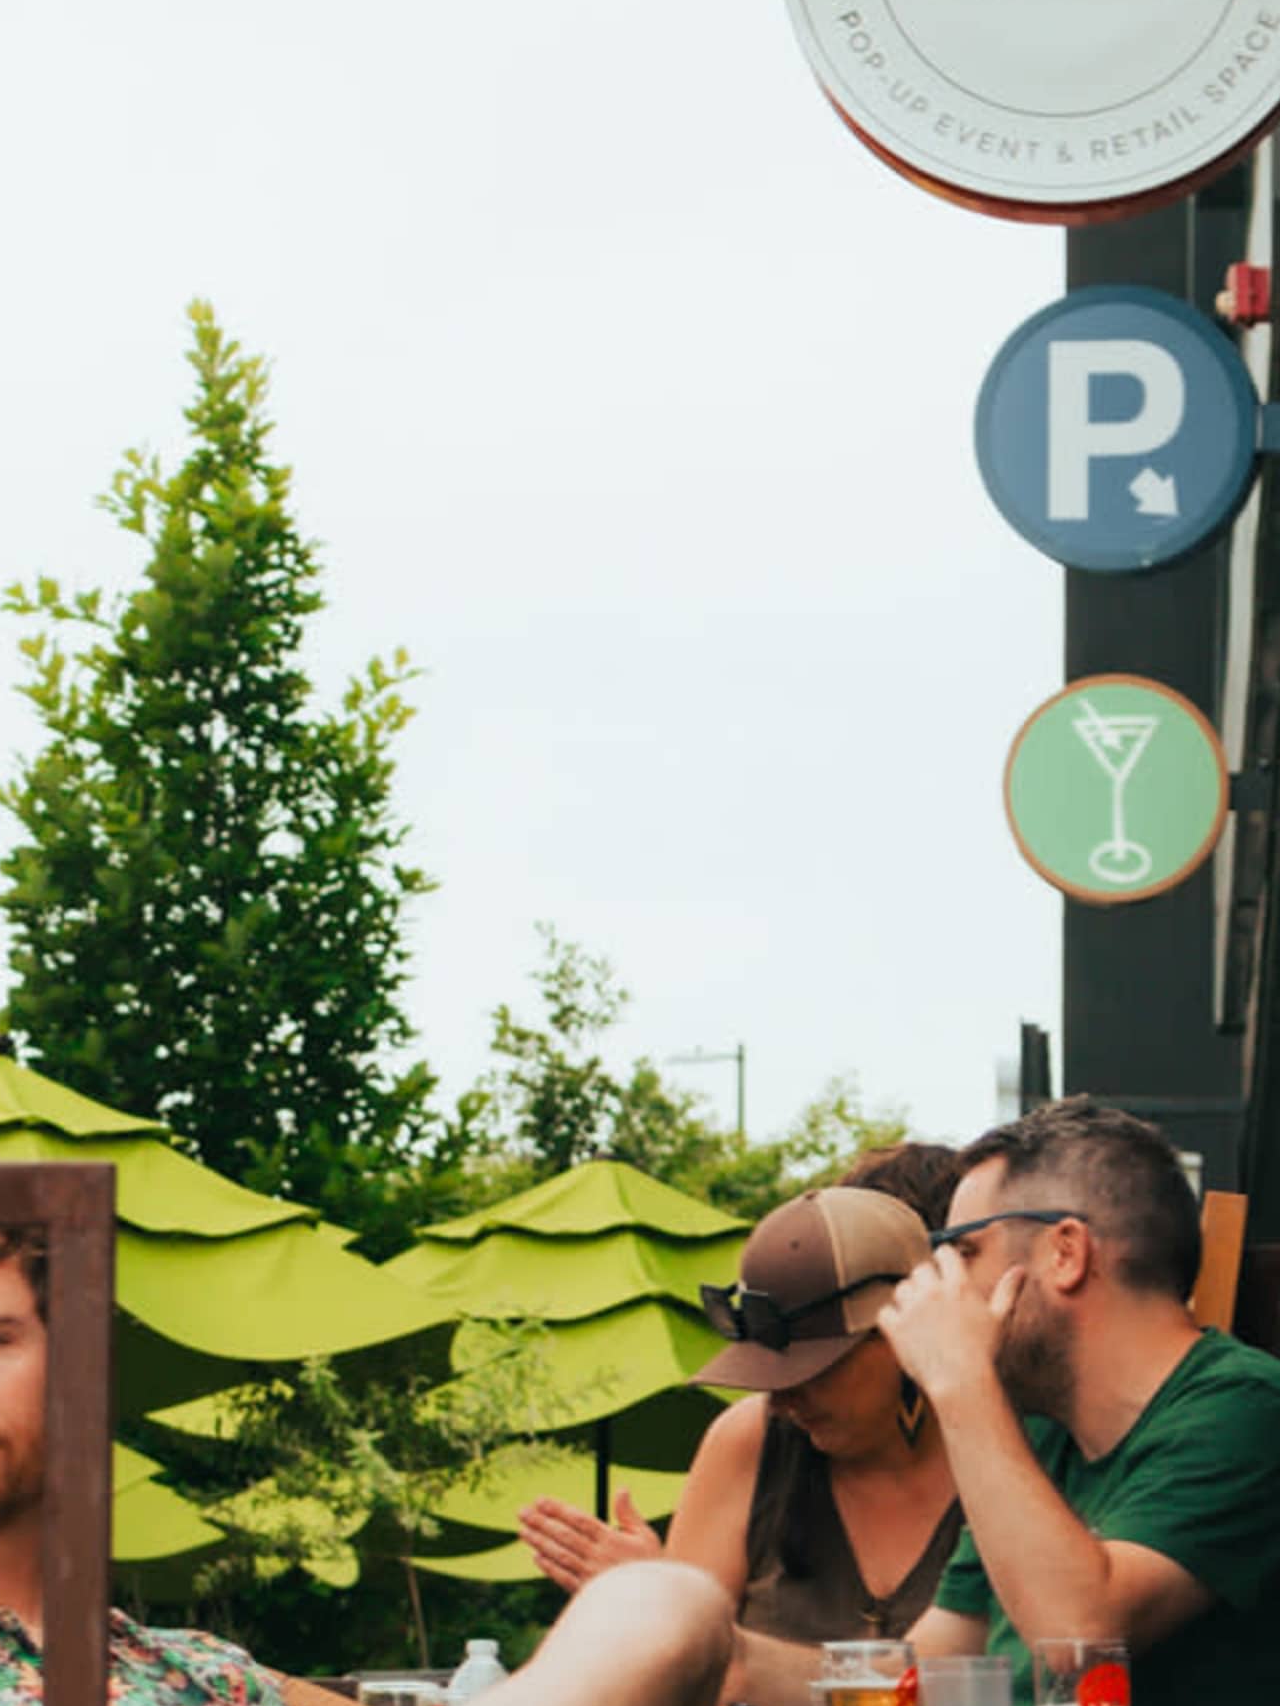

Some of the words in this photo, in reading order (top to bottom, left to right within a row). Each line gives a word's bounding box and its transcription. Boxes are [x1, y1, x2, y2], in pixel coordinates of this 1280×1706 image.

[838, 11, 928, 117] POP-UP
[934, 114, 1040, 161] EVENT
[1056, 143, 1075, 164] &
[1091, 108, 1200, 160] RETAIL
[1203, 9, 1280, 104] SPACE
[1047, 340, 1186, 520] P
